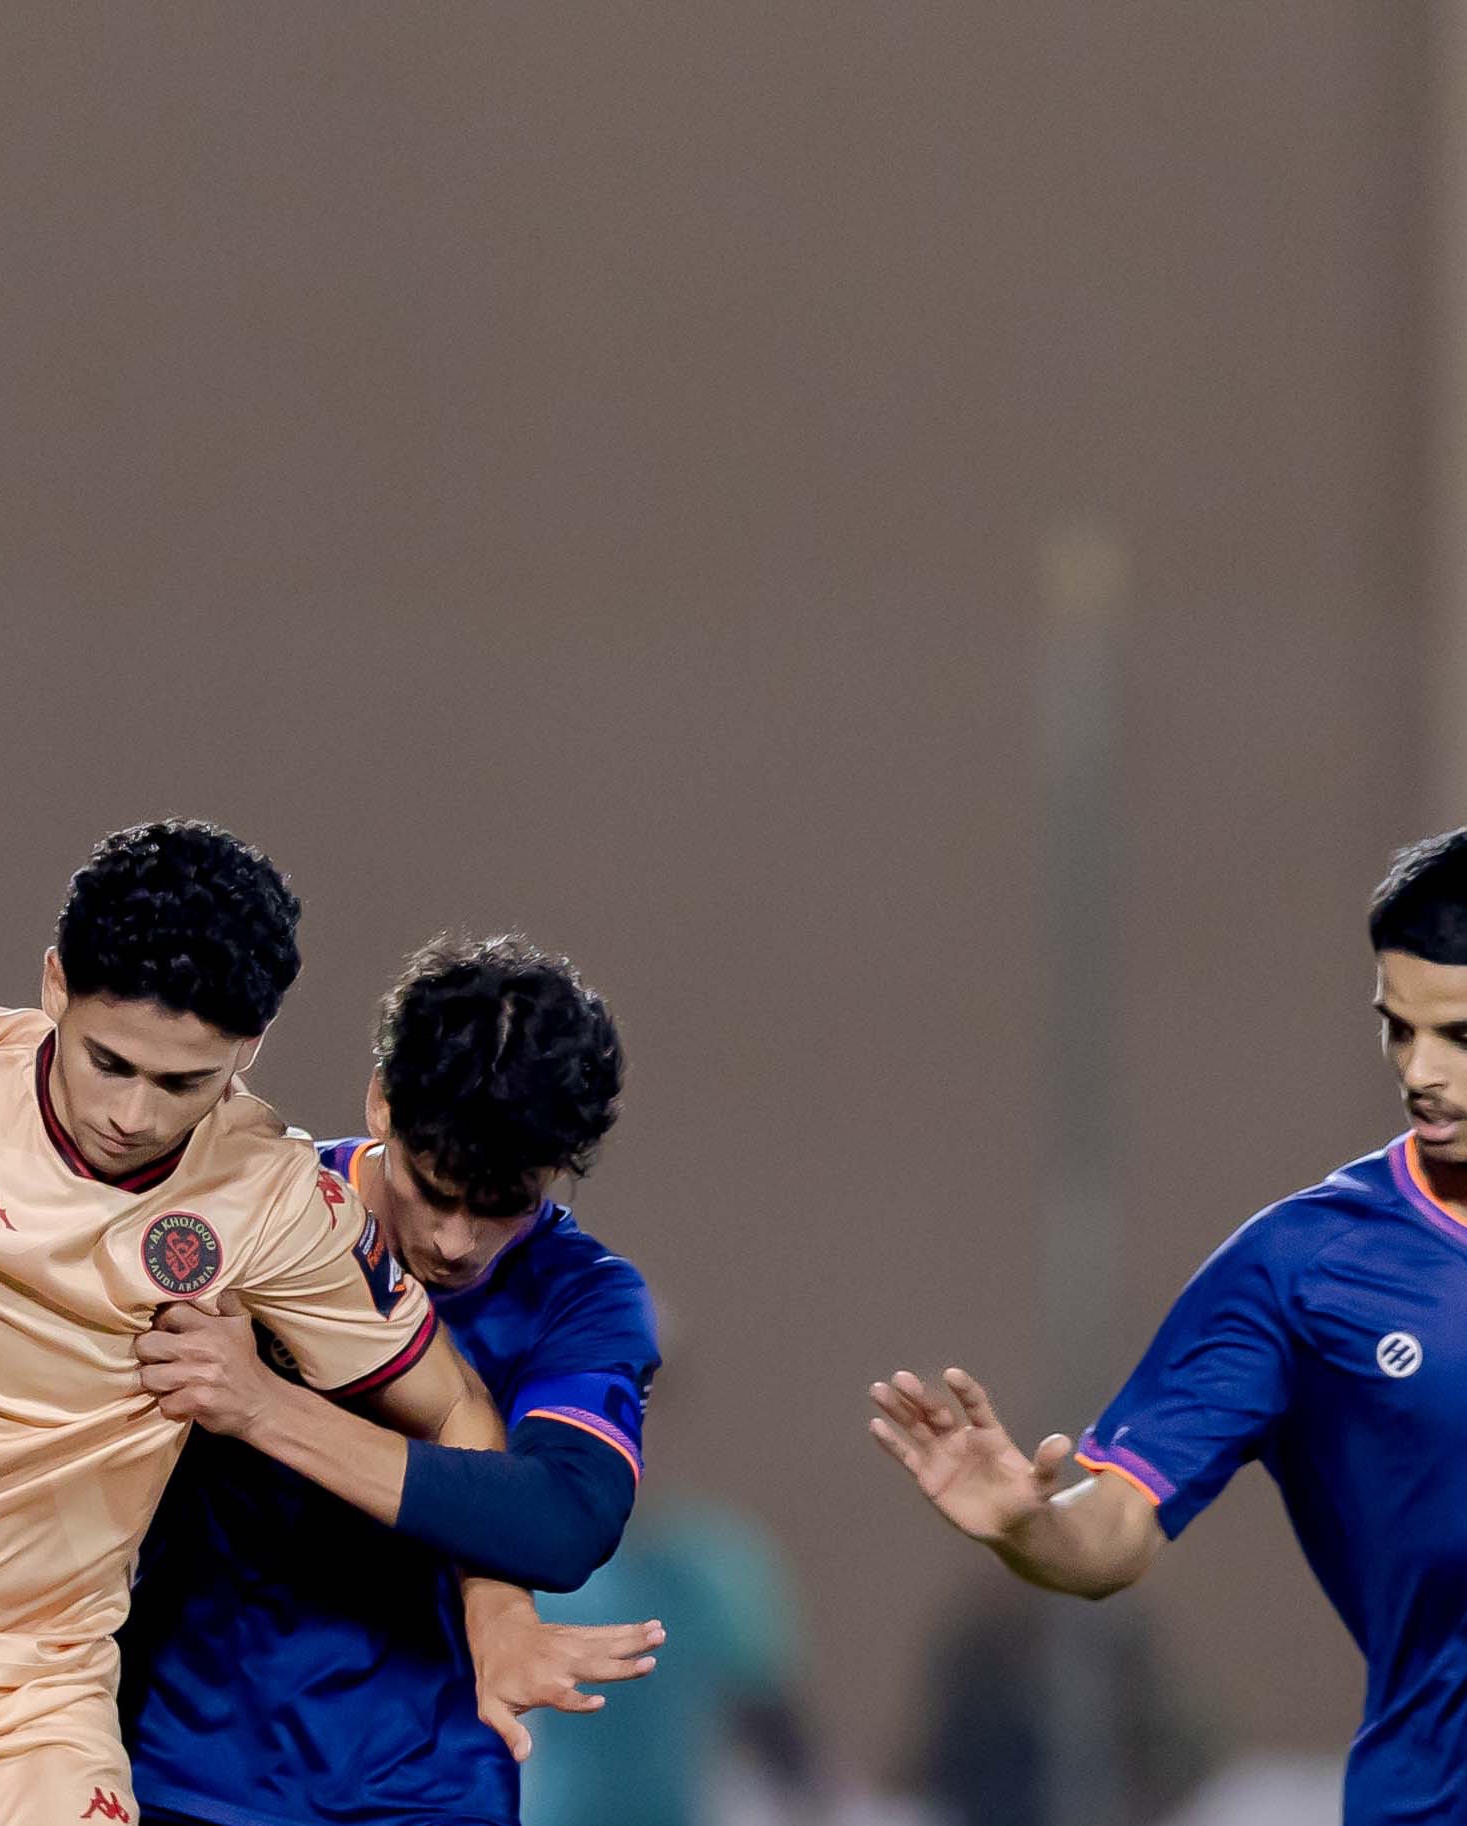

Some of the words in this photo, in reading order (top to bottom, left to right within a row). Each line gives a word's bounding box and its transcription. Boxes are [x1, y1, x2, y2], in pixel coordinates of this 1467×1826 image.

[150, 1228, 164, 1244] AL
[161, 1217, 217, 1251] KHOLOOD
[149, 1257, 174, 1288] SAUDI
[178, 1265, 215, 1292] ARABIA
